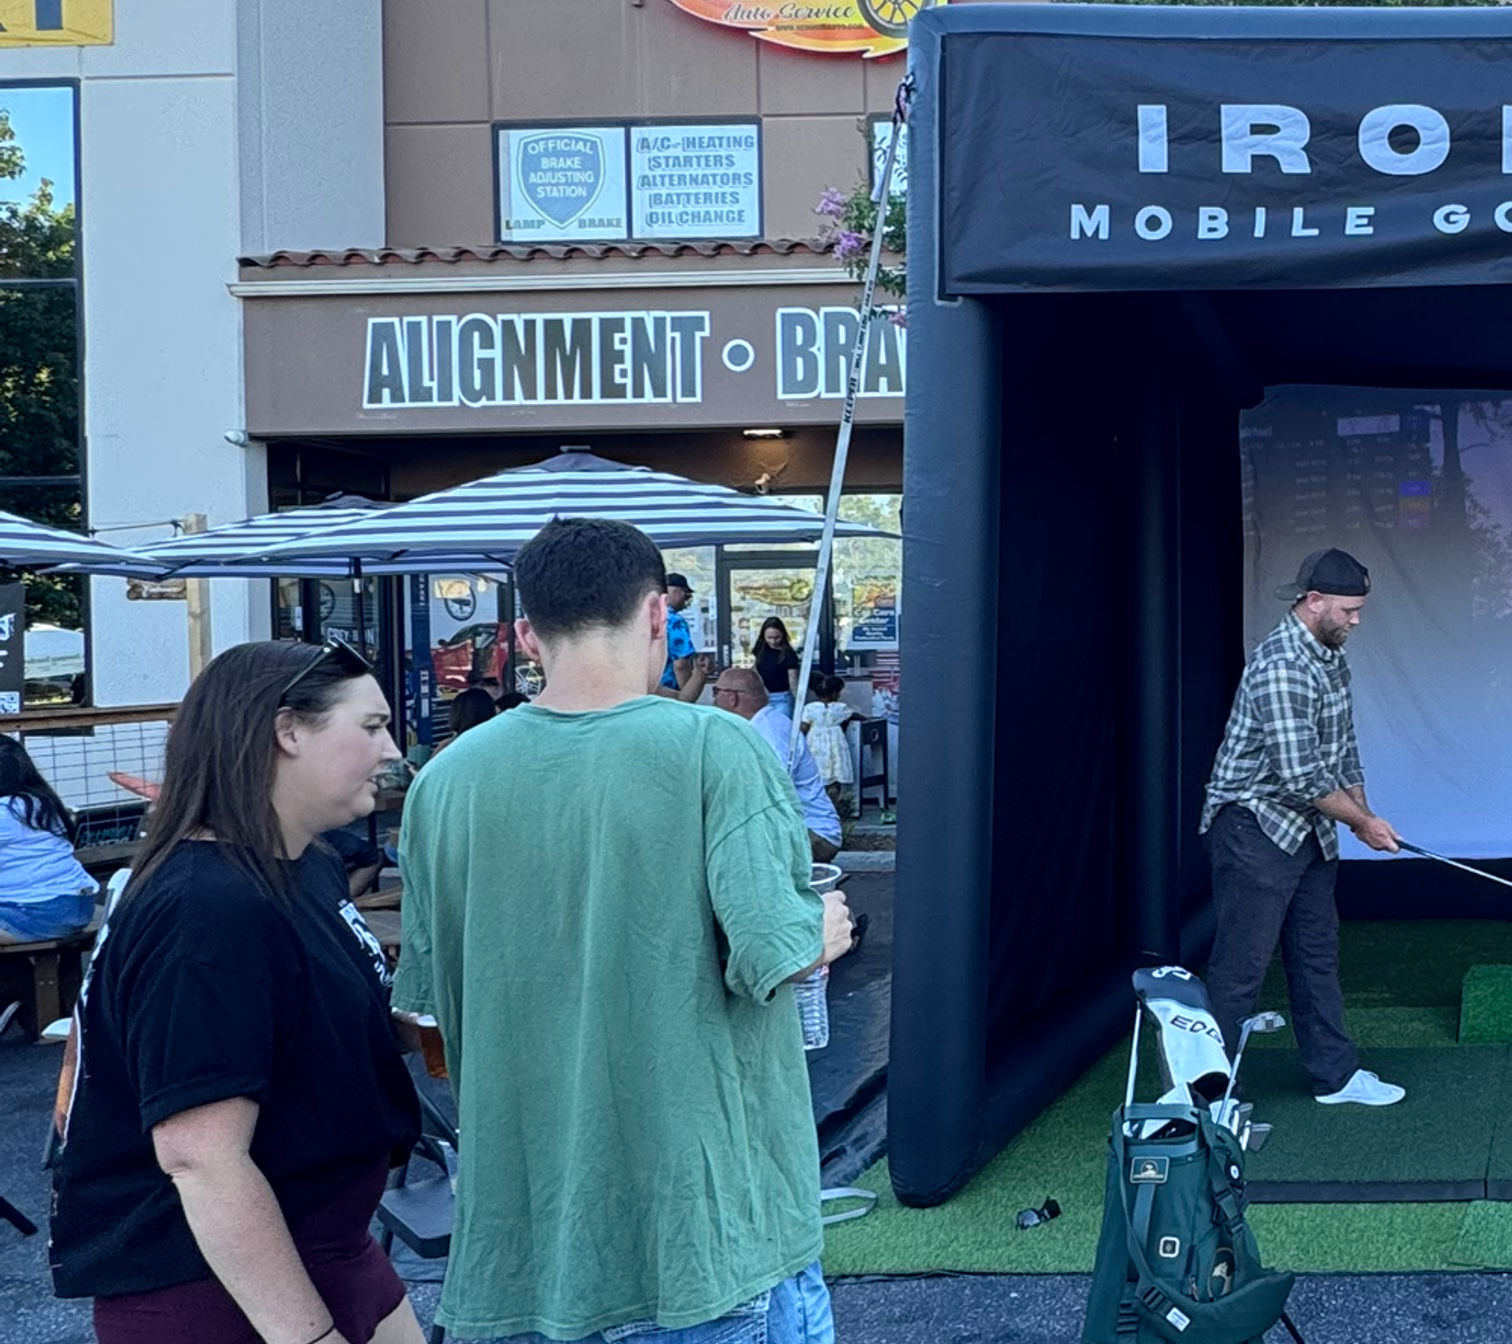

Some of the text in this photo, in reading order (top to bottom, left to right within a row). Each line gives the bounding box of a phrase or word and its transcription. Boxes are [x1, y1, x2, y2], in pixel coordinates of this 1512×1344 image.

[722, 2, 857, 23] Auto Service
[527, 138, 594, 155] OFFICIAL
[638, 136, 671, 152] A/C
[682, 135, 755, 151] HEATING
[541, 157, 582, 169] BRAKE
[648, 154, 737, 171] STARTERS
[529, 171, 594, 184] ADJUSTING
[638, 172, 754, 190] ALTERNATORS
[536, 185, 587, 198] STATION
[648, 191, 740, 208] BATTERIES
[505, 219, 546, 230] LAMP
[577, 217, 622, 229] BRAKE
[645, 209, 746, 227] OIL CHANGE
[1069, 203, 1376, 241] MOBILE
[362, 306, 907, 409] ALIGNMENT BRA
[1170, 1014, 1223, 1044] EDG
